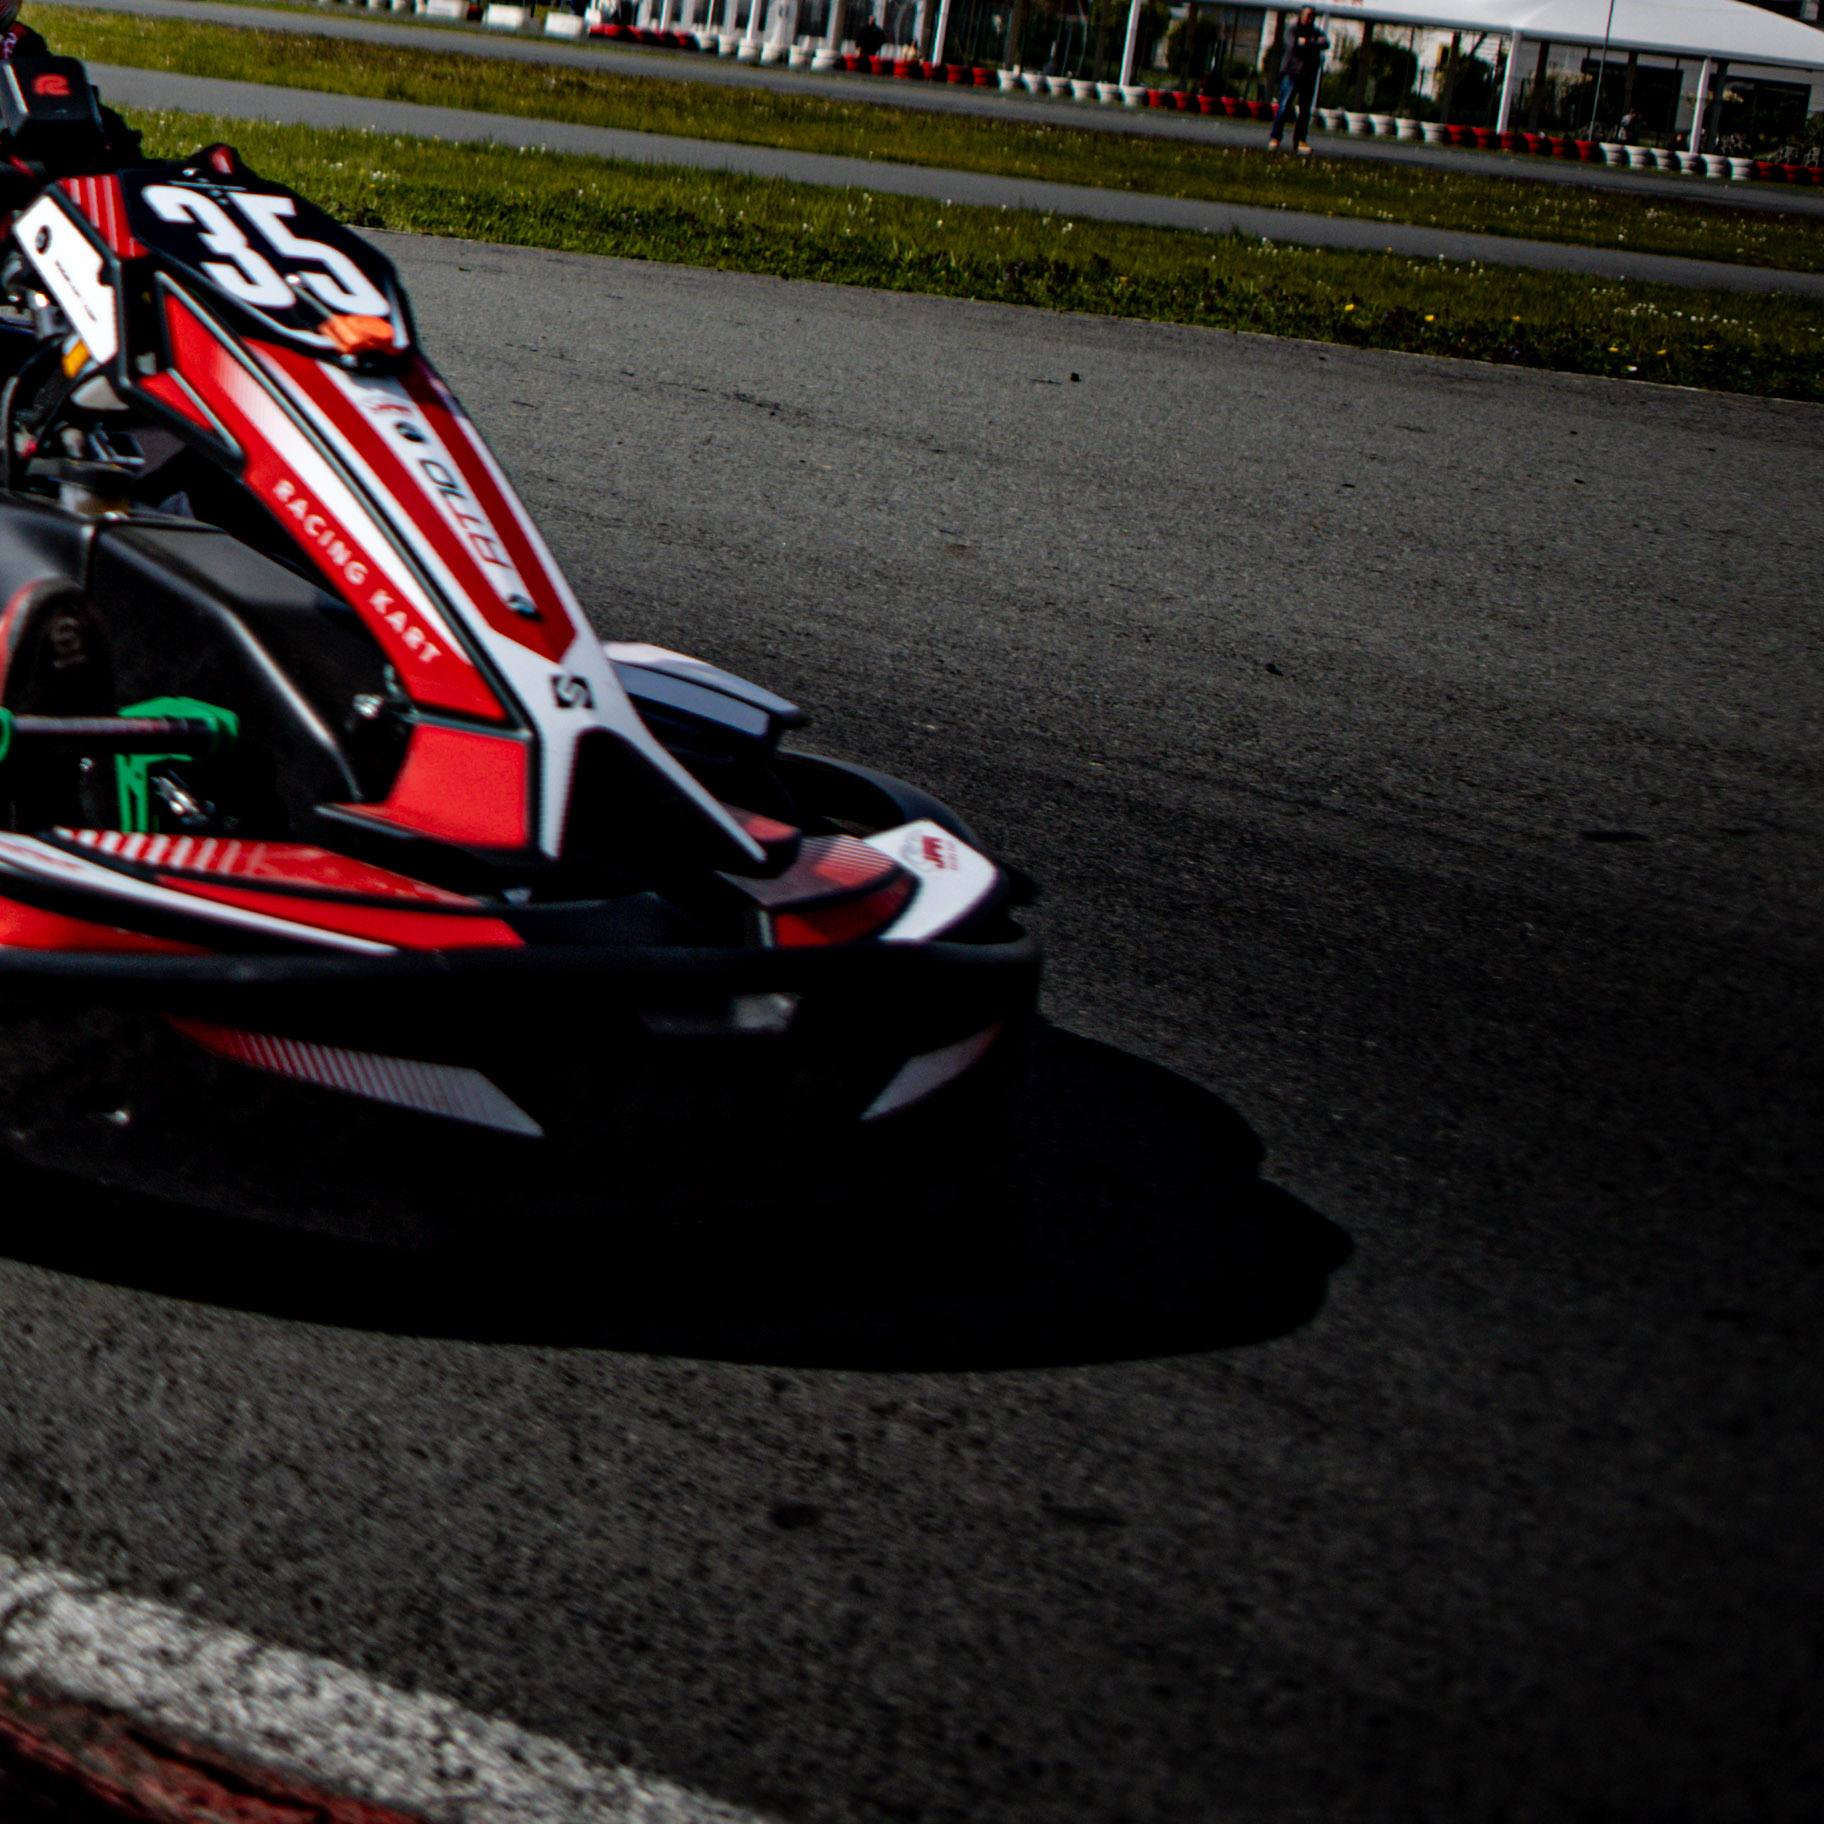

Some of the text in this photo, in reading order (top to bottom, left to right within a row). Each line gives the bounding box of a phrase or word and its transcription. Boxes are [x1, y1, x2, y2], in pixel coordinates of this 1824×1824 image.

[141, 184, 391, 317] 35
[272, 479, 443, 663] RACING KART
